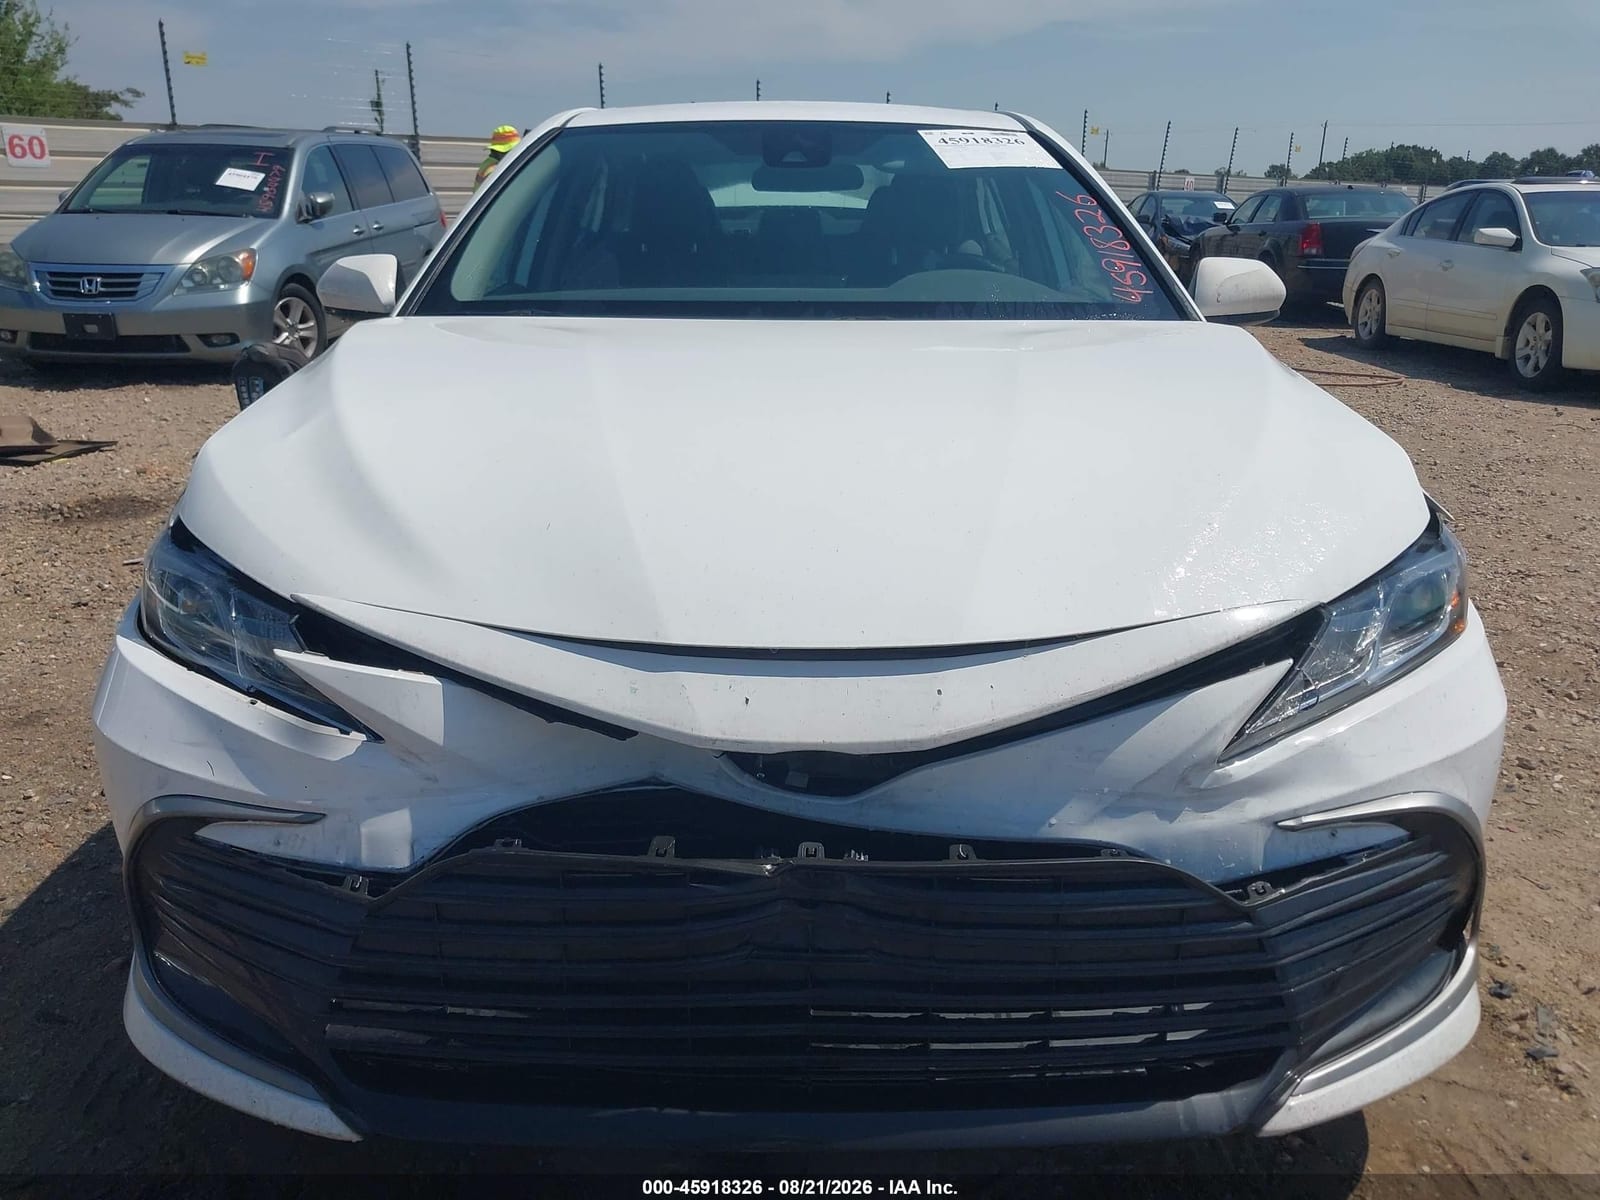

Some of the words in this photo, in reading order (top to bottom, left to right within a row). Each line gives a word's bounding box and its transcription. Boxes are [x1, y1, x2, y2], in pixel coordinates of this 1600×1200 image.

[8, 134, 46, 160] 60
[938, 136, 1026, 146] 45918326
[1056, 191, 1154, 303] 45918326
